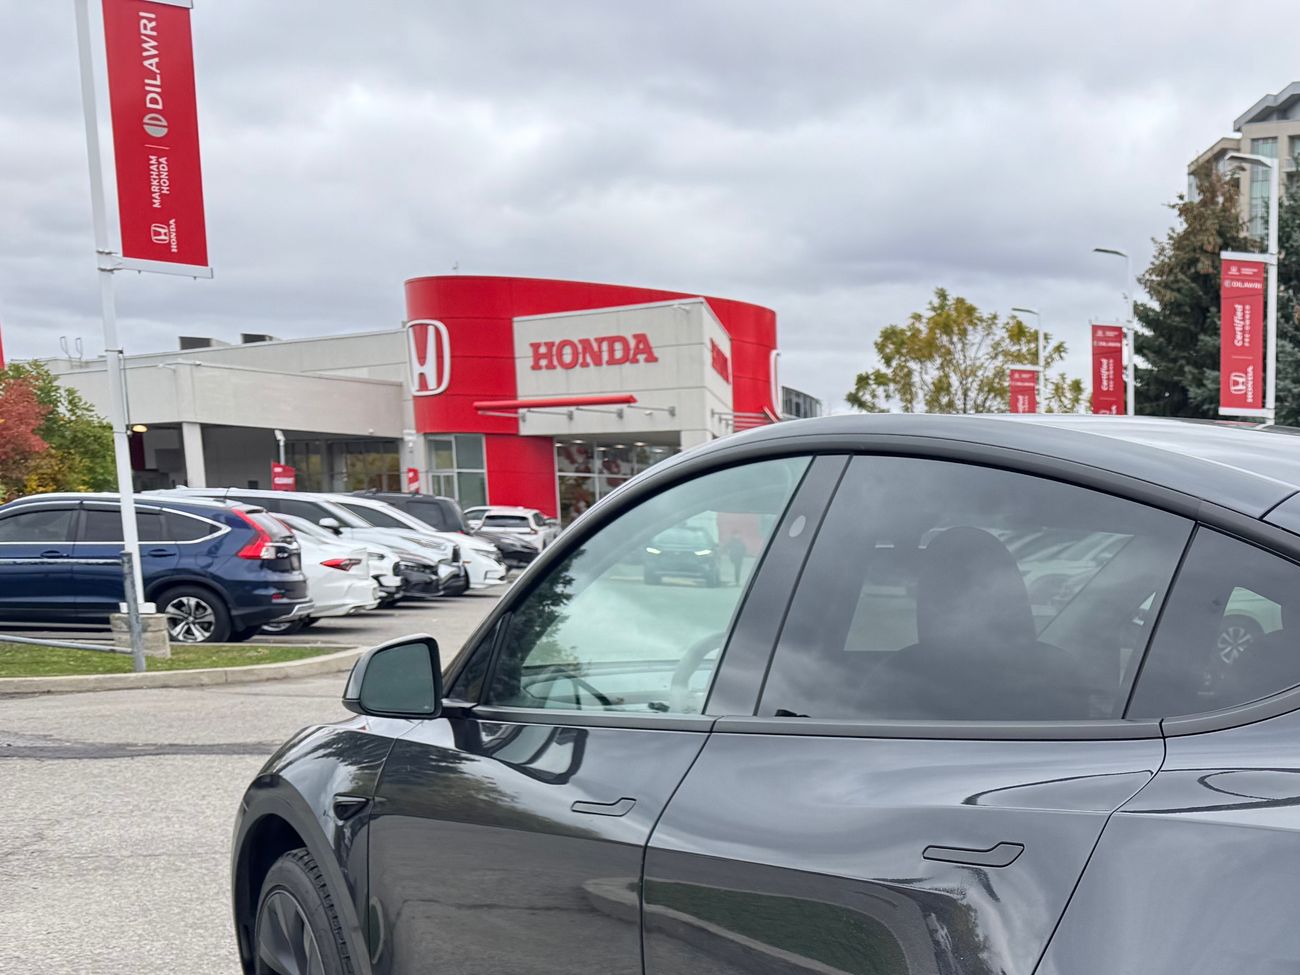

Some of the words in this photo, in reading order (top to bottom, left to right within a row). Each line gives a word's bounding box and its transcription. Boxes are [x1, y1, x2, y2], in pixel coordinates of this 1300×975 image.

[138, 11, 163, 110] DILAWRI
[149, 155, 162, 208] MARKHAM
[158, 156, 170, 194] HONDA
[169, 218, 178, 253] HONDA
[529, 333, 659, 371] HONDA
